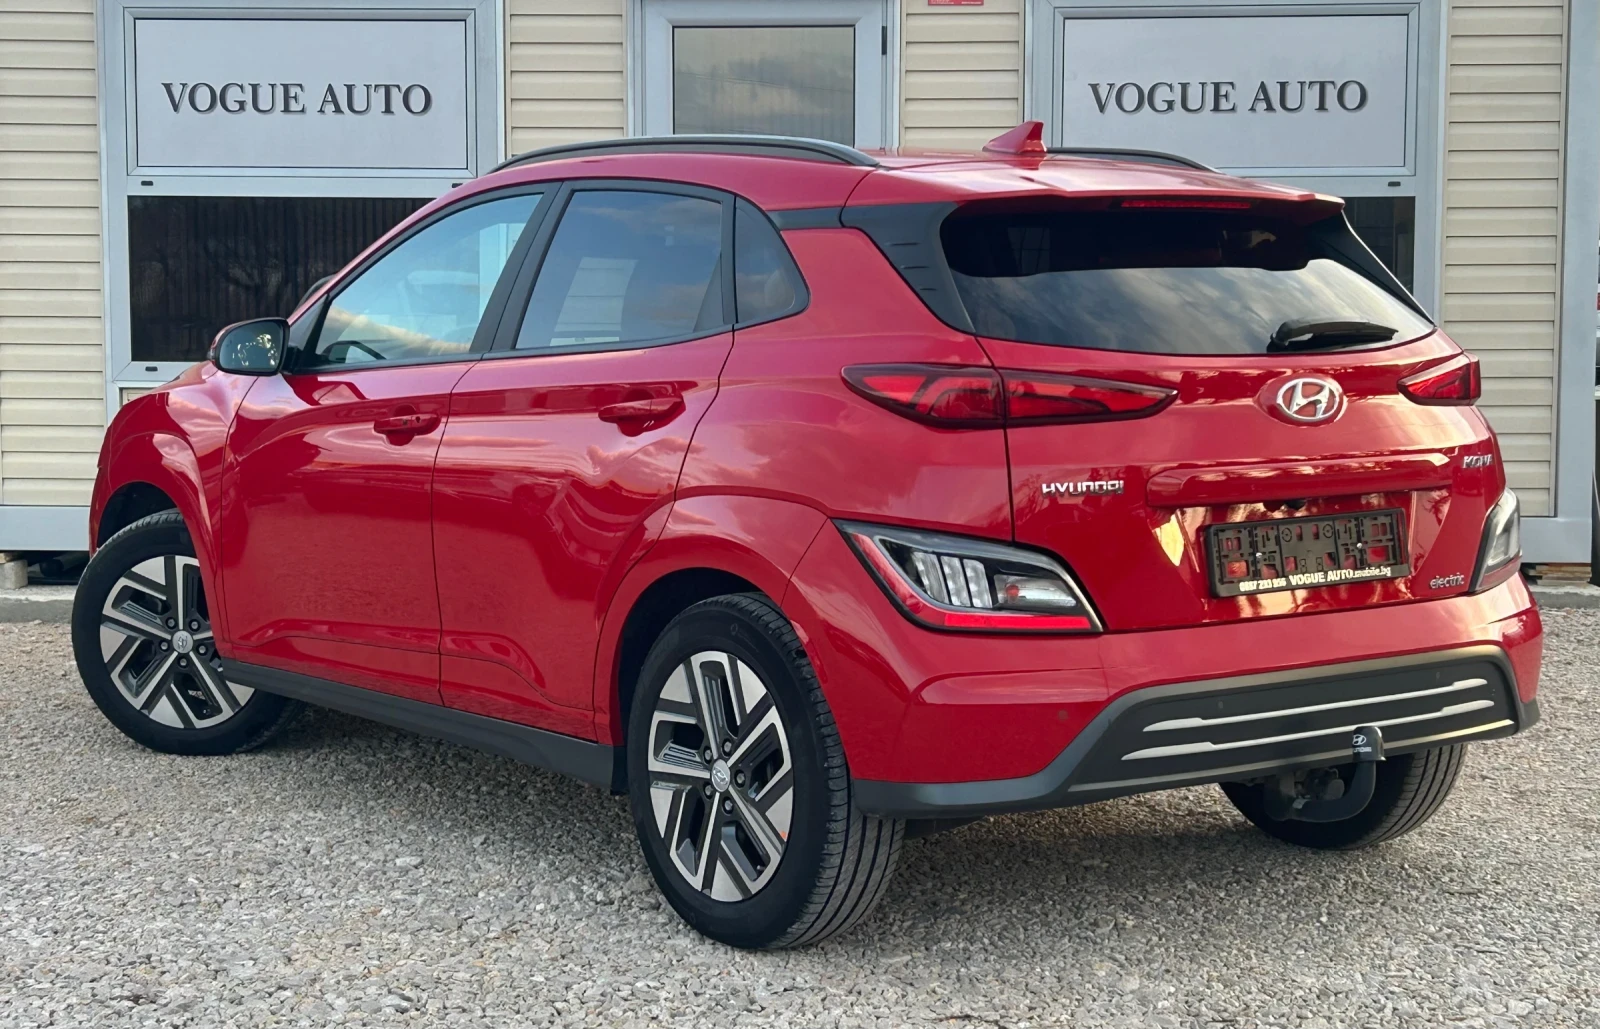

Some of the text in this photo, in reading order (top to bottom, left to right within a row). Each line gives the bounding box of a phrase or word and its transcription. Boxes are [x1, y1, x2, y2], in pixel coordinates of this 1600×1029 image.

[161, 82, 434, 115] VOGUE AUTO
[1088, 79, 1369, 114] VOGUE AUTO
[1041, 480, 1125, 496] HYUNDAI
[1289, 571, 1326, 587] VOGUE
[1430, 572, 1465, 589] electric
